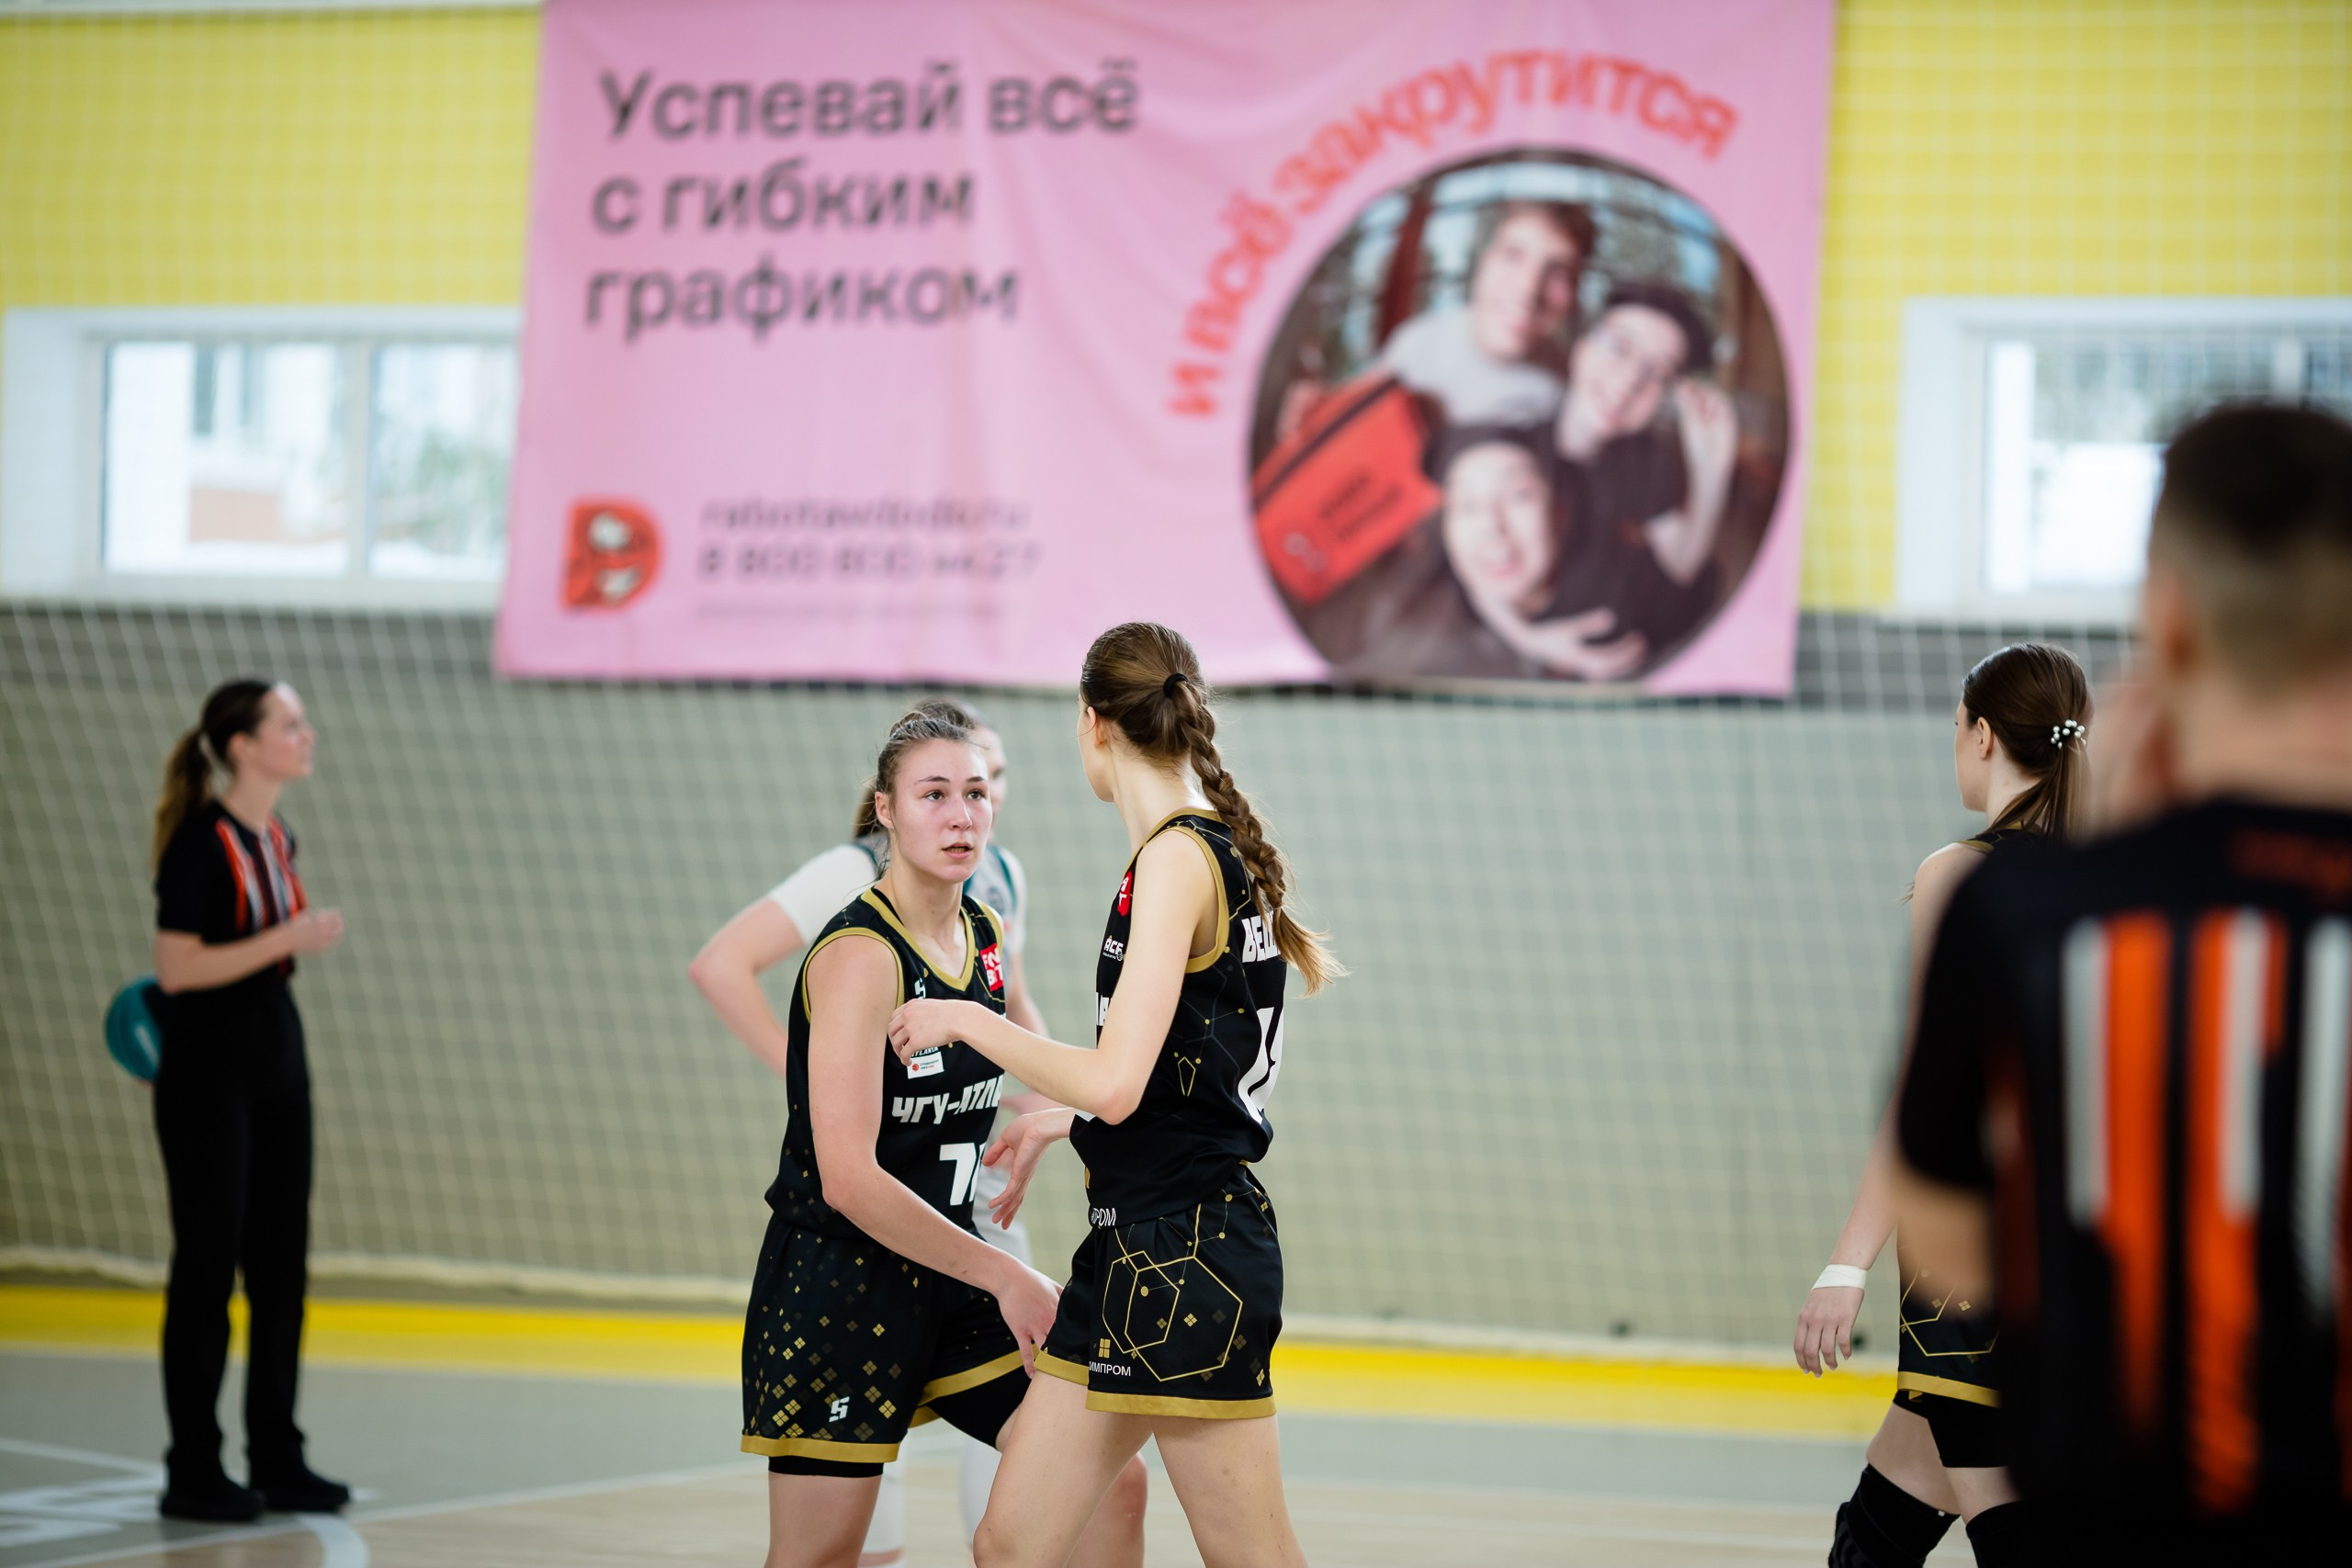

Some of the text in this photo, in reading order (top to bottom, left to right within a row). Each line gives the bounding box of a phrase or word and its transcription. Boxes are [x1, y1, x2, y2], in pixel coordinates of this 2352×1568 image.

[599, 58, 1141, 141] Успевай всё
[592, 157, 976, 234] с гибким
[1169, 50, 1739, 418] и всё закрутится
[585, 254, 1020, 344] графиком
